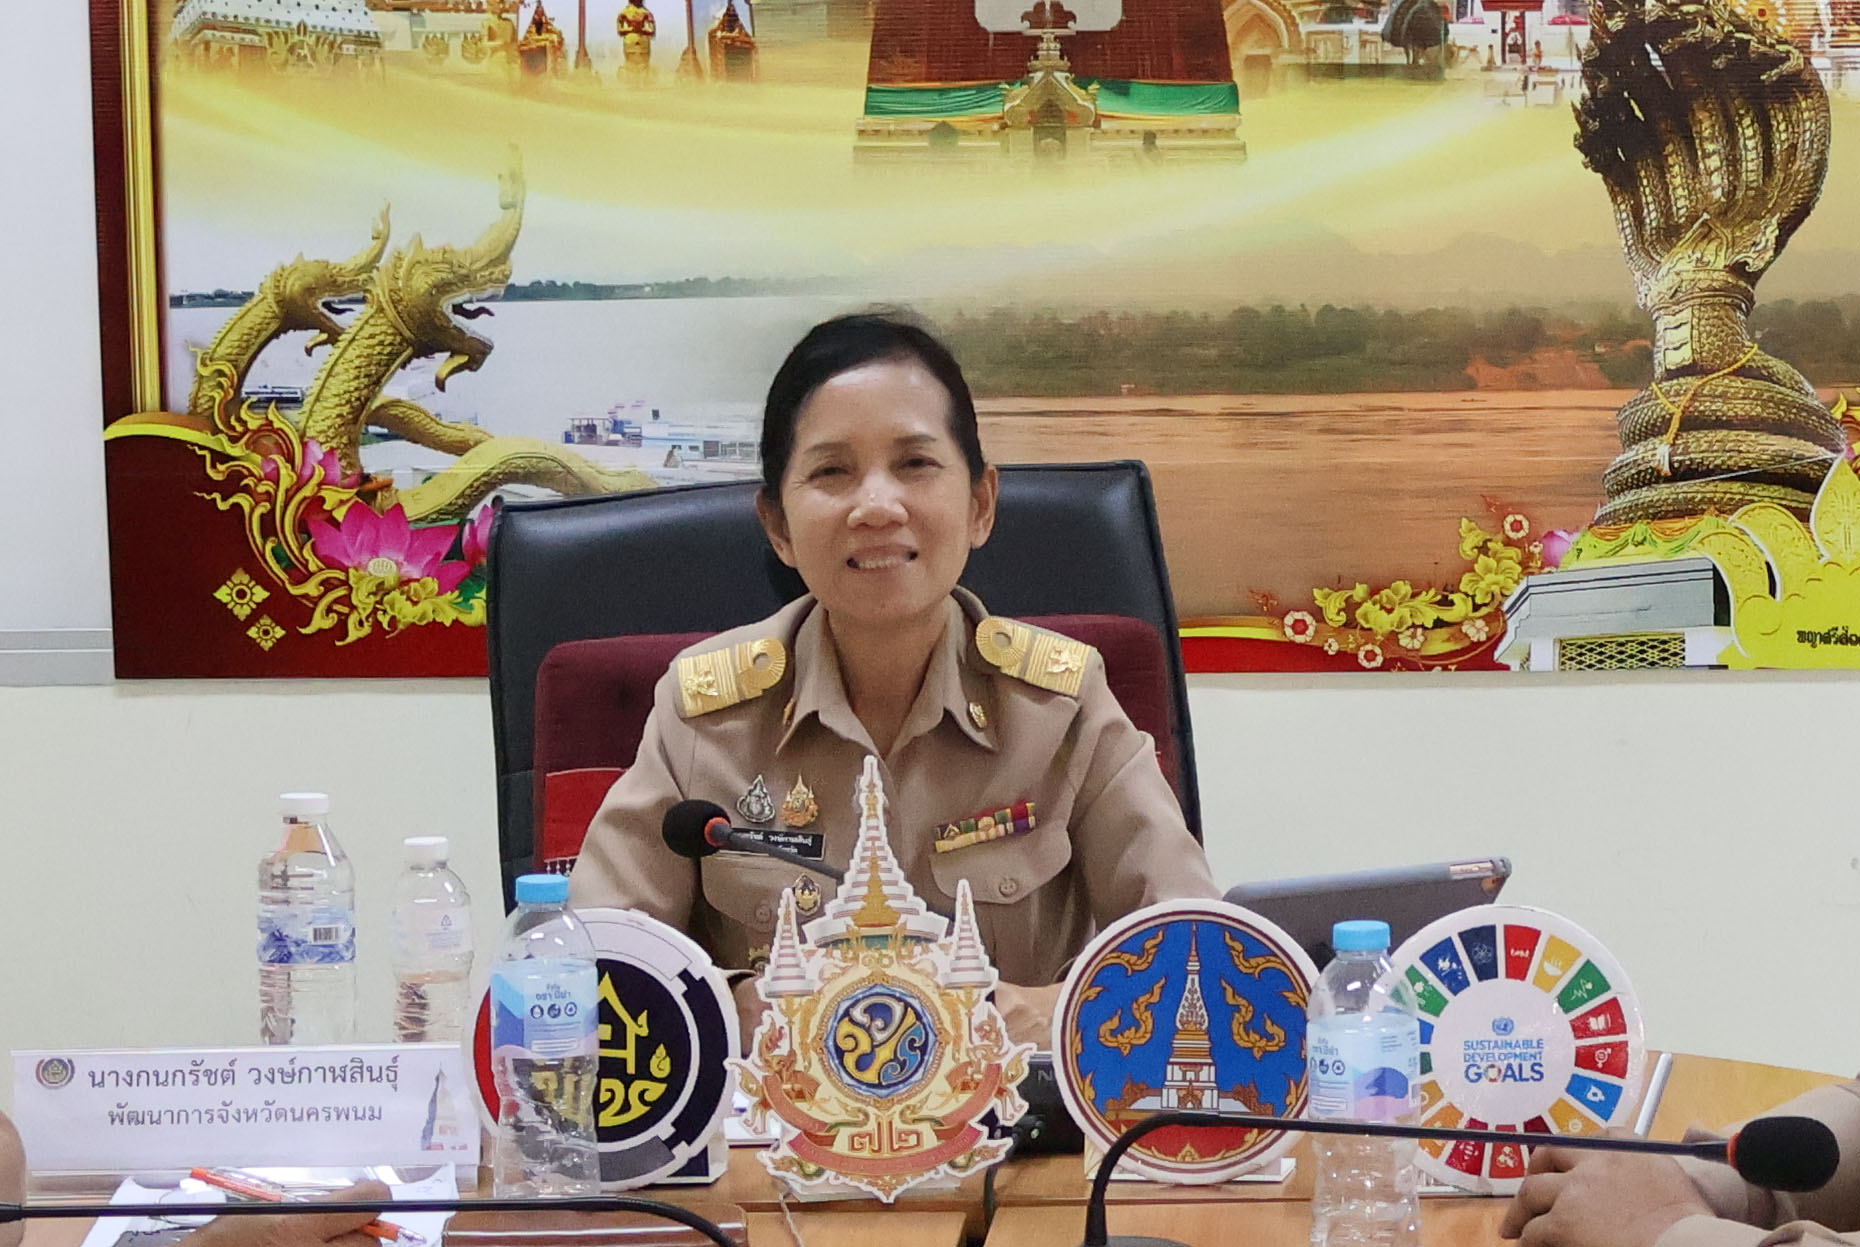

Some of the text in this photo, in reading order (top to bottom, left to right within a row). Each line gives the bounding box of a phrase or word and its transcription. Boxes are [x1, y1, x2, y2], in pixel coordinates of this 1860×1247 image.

[1463, 1039, 1544, 1051] SUSTAINABLE
[1463, 1051, 1543, 1063] DEVELOPMENT
[87, 1054, 400, 1093] นางกนกรัชต์ วงษ์กาฬสินธุ์
[1464, 1062, 1545, 1083] GOALS
[107, 1099, 383, 1126] พัฒนาการจังหวัดนครพนม
